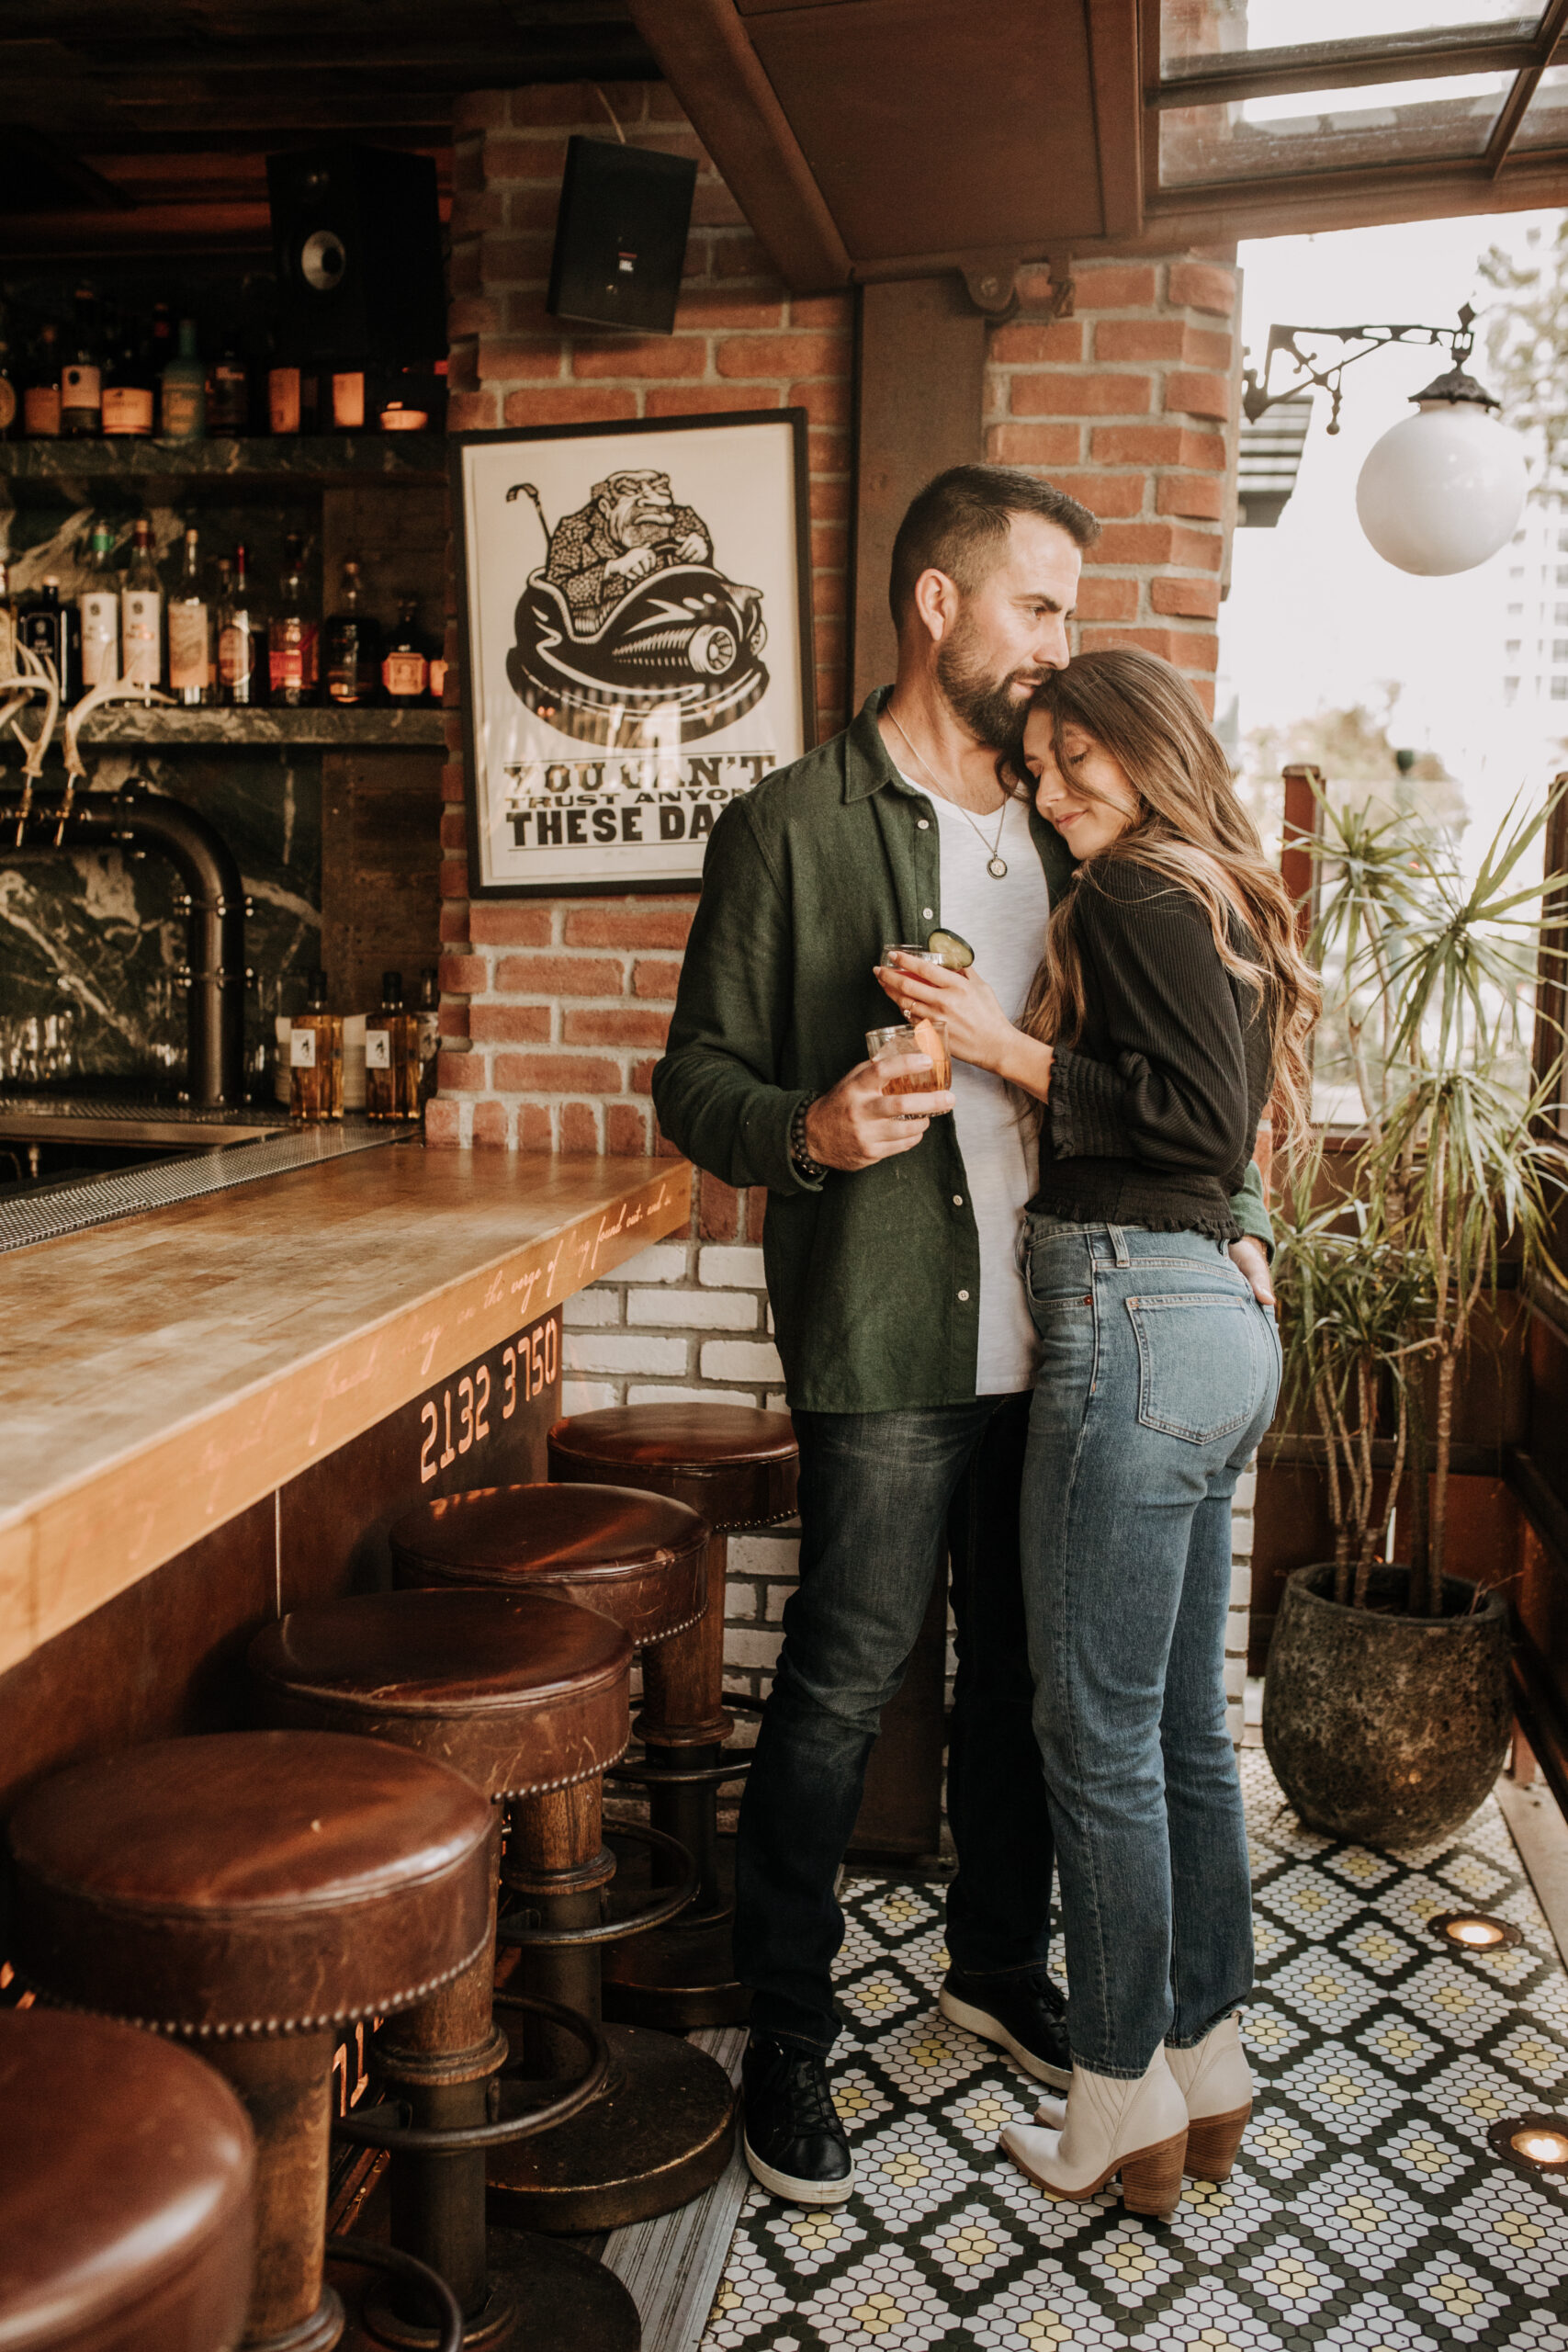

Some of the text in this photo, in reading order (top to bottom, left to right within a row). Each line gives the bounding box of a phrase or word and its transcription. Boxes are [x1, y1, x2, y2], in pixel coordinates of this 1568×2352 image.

[504, 793, 621, 809] TRUST
[505, 803, 728, 846] THESE DA
[483, 1270, 504, 1308] the
[511, 1267, 542, 1314] verge
[547, 1238, 564, 1298] of
[568, 1229, 591, 1279] bng
[591, 1203, 627, 1271] found
[647, 1182, 666, 1216] and
[420, 1364, 491, 1484] 2132
[502, 1317, 558, 1419] 3750
